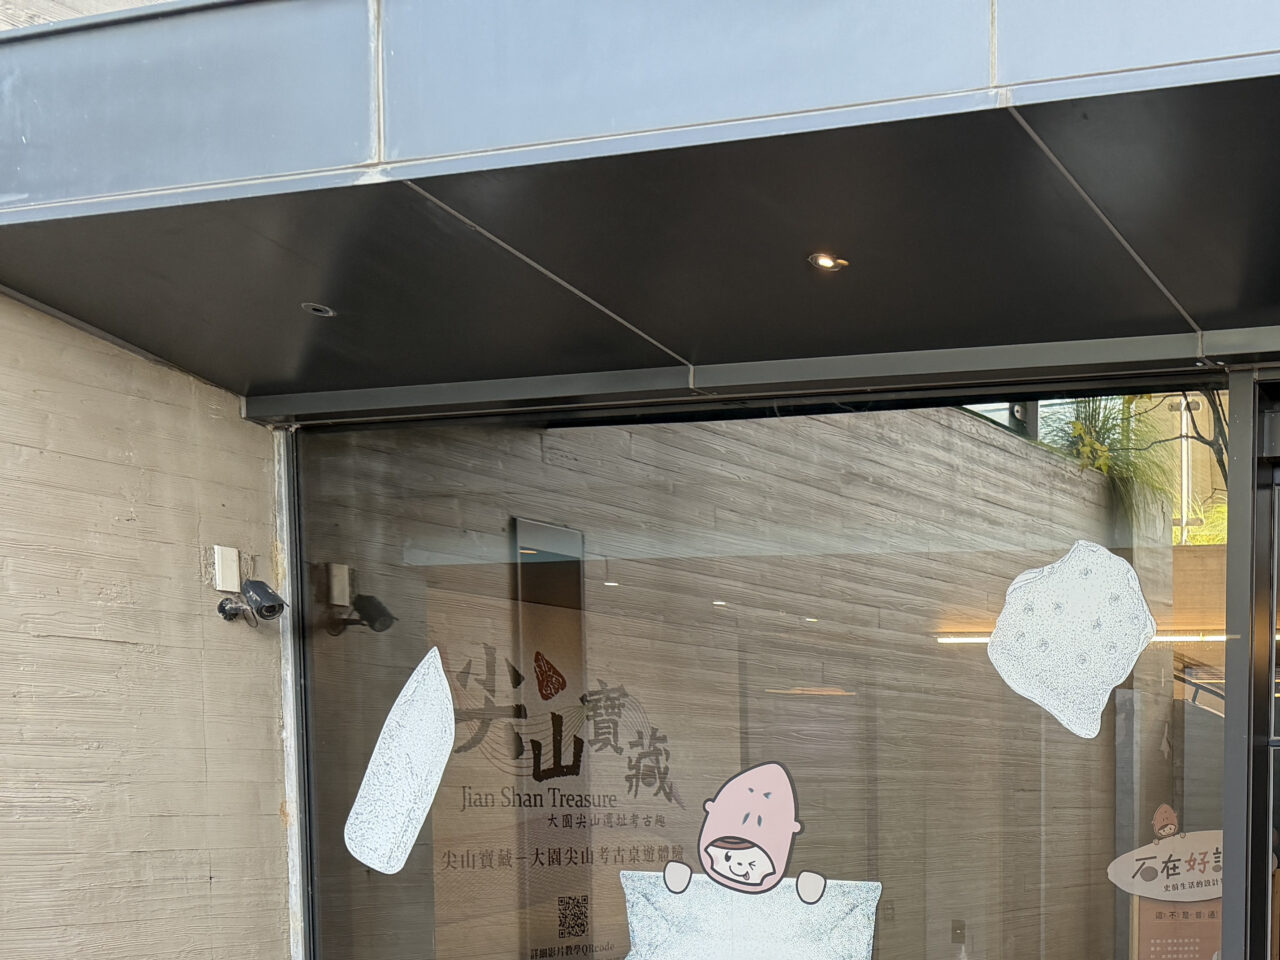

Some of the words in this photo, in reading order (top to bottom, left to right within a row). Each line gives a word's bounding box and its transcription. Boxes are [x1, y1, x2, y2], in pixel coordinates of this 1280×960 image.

[460, 785, 494, 812] Jian
[500, 786, 544, 808] Shan
[548, 787, 618, 808] Treasure
[1164, 878, 1222, 892] 史前生活的設計
